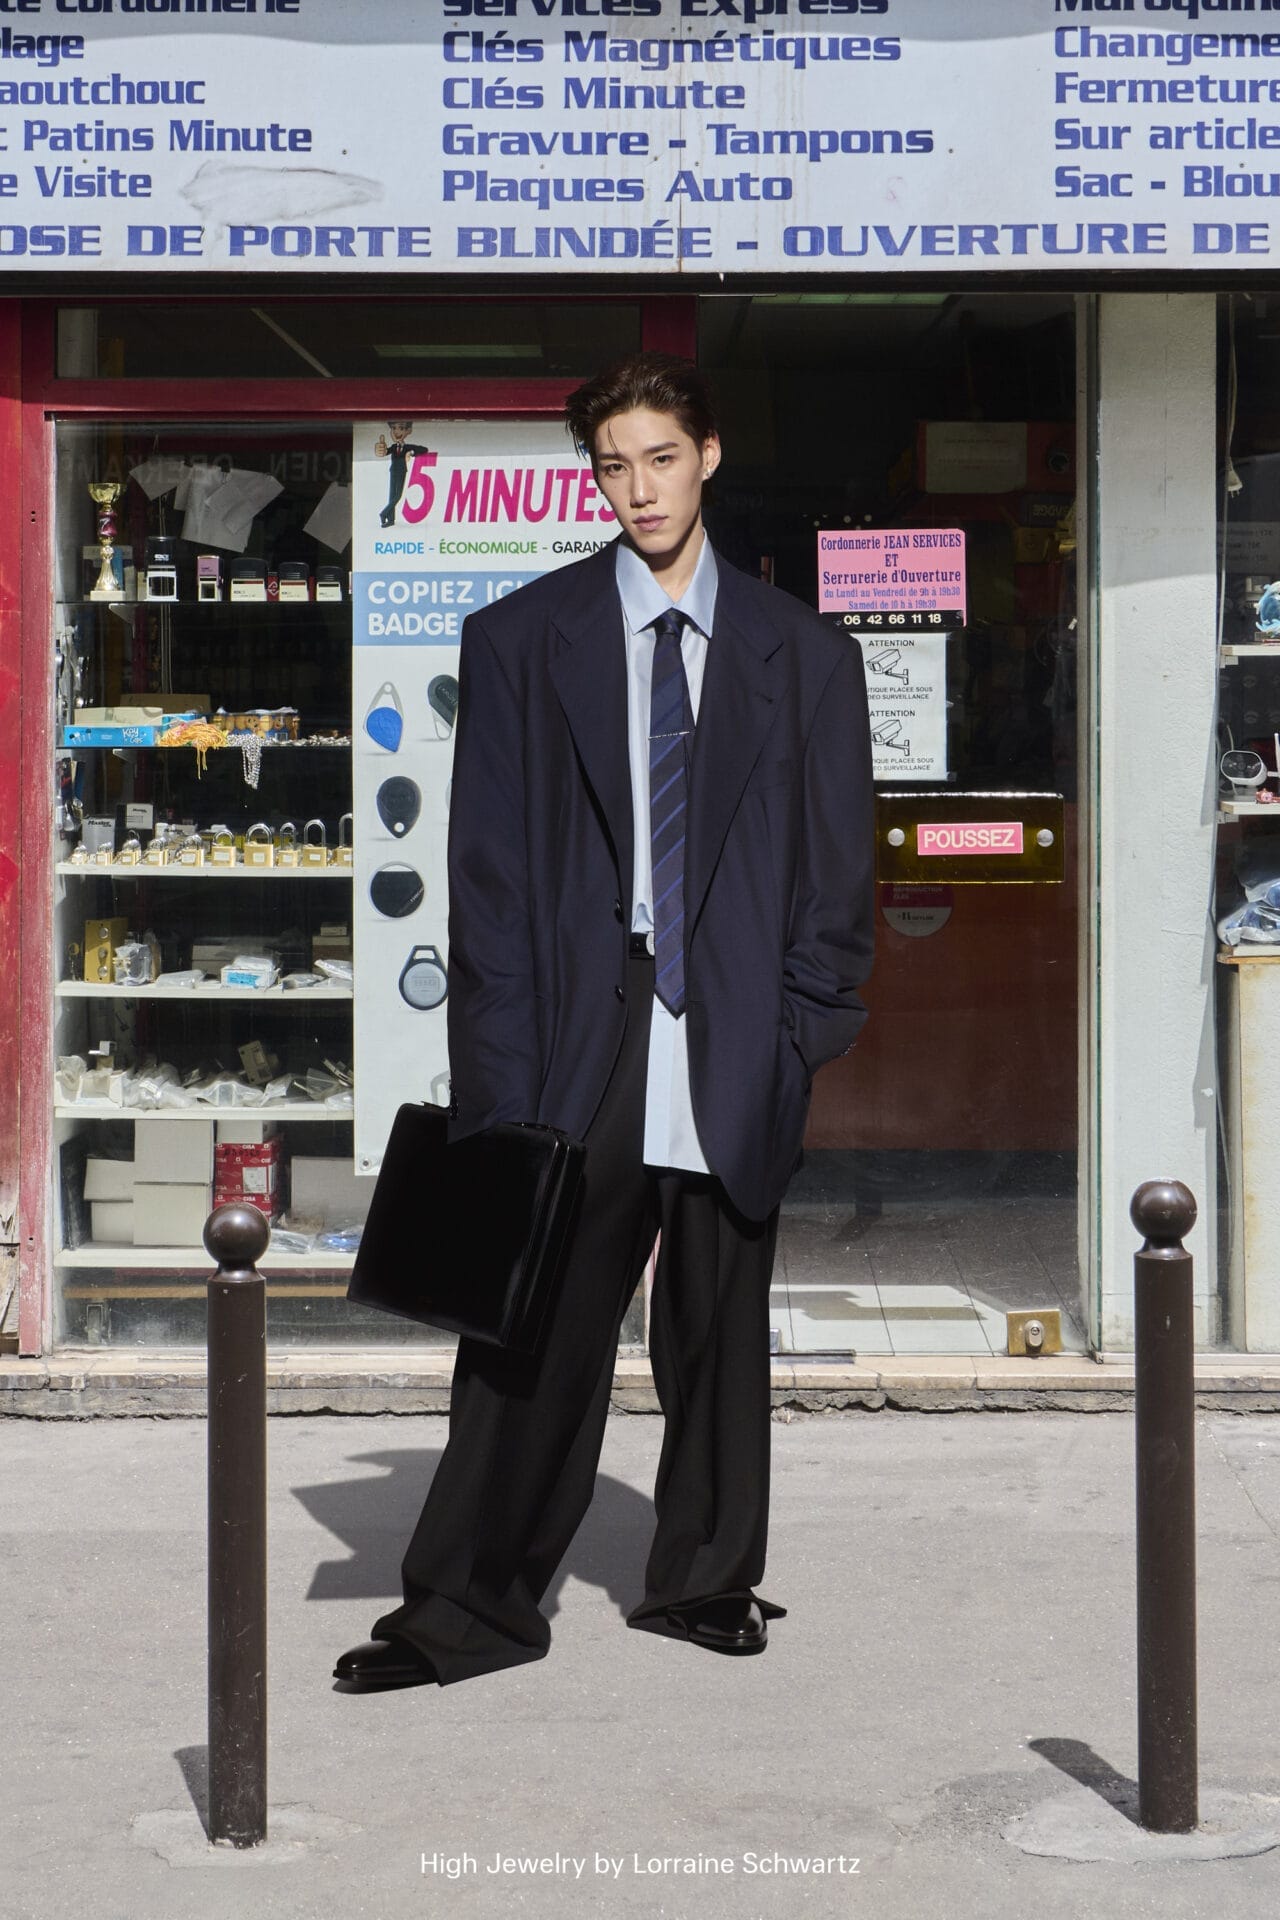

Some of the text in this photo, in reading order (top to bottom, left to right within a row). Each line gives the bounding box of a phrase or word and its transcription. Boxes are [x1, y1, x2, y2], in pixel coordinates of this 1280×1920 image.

[0, 26, 84, 67] lage
[443, 30, 900, 70] Clés Magnétiques
[443, 77, 745, 109] Clés Minute
[24, 120, 153, 151] Patins
[170, 120, 312, 152] Minute
[443, 124, 933, 162] Gravure - Tampons
[1055, 119, 1131, 149] Sur
[35, 166, 151, 197] Visite
[443, 170, 792, 210] Plaques Auto
[1055, 166, 1132, 197] Sac
[1151, 181, 1165, 189] -
[128, 226, 204, 256] DE
[227, 225, 431, 257] PORTE
[458, 220, 712, 262] BLINDÉE
[737, 242, 758, 250] -
[783, 224, 1166, 256] OUVERTURE
[1194, 223, 1269, 253] DE
[375, 541, 425, 554] RAPIDE
[439, 538, 538, 555] ÉCONOMIQUE
[821, 533, 961, 551] Cordonnerie JEAN SERVICES
[885, 553, 899, 567] ET
[823, 569, 961, 585] Serrurerie d'Ouverture
[368, 580, 524, 604] COPIEZ IC
[824, 589, 834, 598] du
[836, 588, 858, 598] Lundi
[861, 589, 870, 598] au
[873, 586, 906, 598] Vendredi
[908, 587, 918, 597] de
[939, 586, 961, 596] 19h30
[848, 600, 877, 610] Samedi
[880, 600, 889, 610] de
[915, 599, 937, 609] 19h30
[368, 612, 458, 636] BADGE
[843, 613, 942, 625] 06 42 66 11 18
[923, 829, 1015, 849] POUSSEZ
